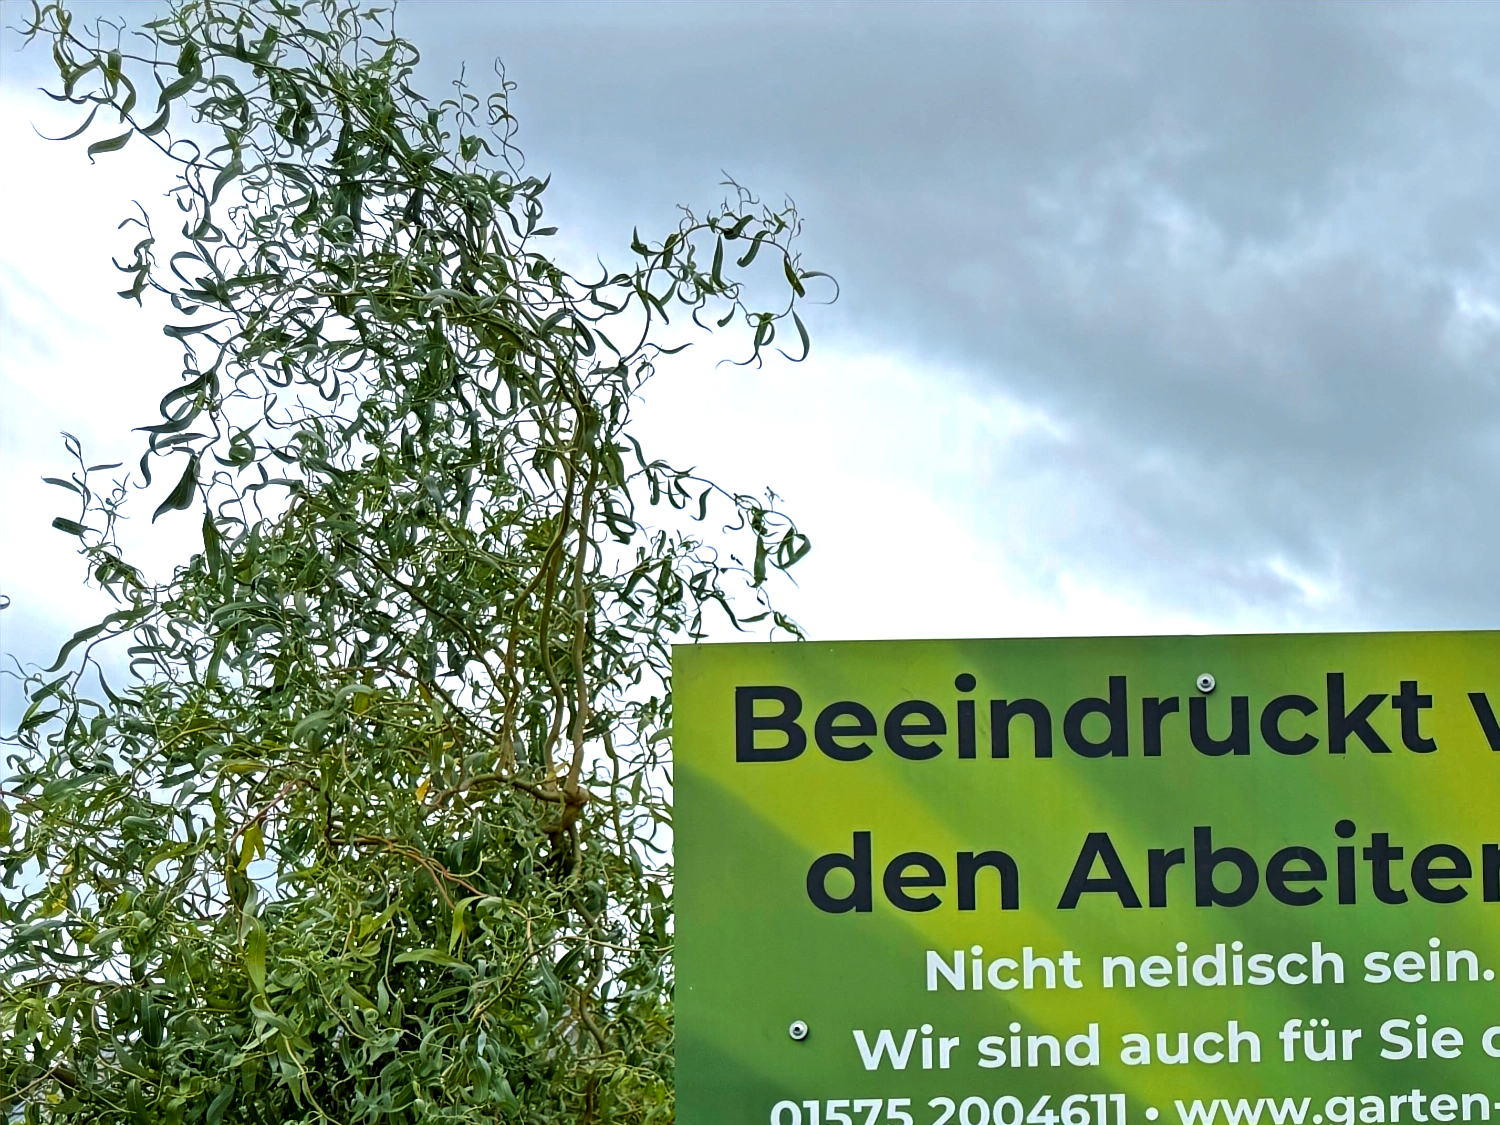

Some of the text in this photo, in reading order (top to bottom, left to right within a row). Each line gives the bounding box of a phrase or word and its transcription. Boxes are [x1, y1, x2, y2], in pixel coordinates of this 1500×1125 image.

[735, 673, 1438, 763] Beeindruckt
[806, 830, 1020, 914] den
[926, 937, 1495, 991] Nicht neidisch sein.
[852, 1023, 960, 1071] Wir
[978, 1022, 1100, 1069] sind
[1120, 1020, 1261, 1066] auch
[1278, 1018, 1362, 1062] für
[1379, 1014, 1464, 1060] Sie
